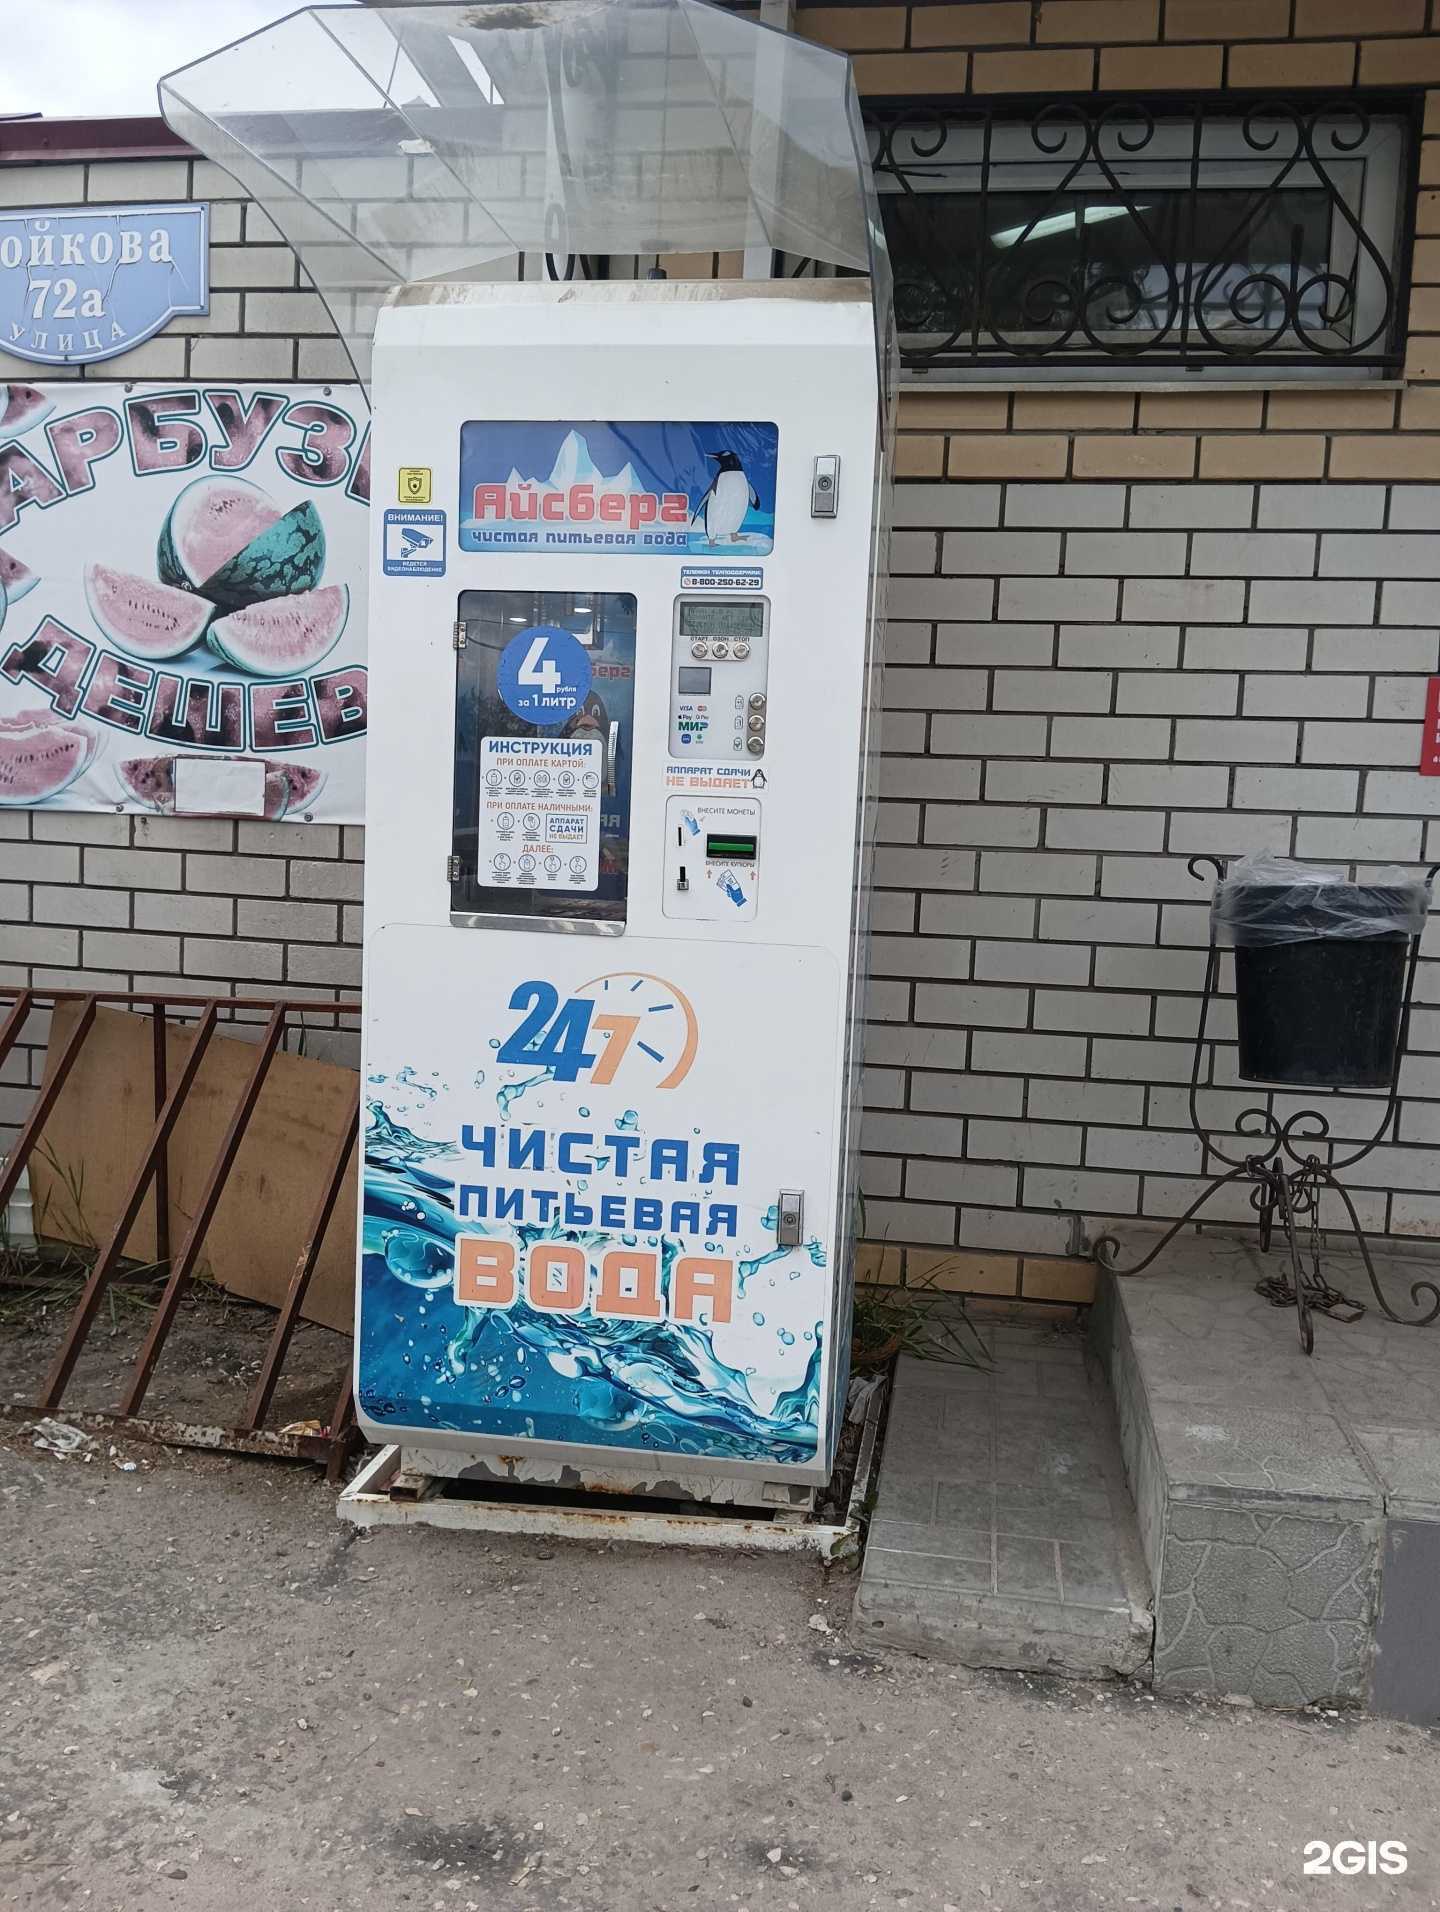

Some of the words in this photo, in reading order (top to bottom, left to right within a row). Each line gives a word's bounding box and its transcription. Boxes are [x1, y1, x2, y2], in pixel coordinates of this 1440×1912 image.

[29, 278, 106, 319] 72а
[9, 320, 127, 351] УЛИЦА
[0, 388, 370, 536] АРБУЗ
[474, 483, 688, 530] Айсберг
[387, 513, 443, 522] ВНИМАНИЕ!
[472, 531, 538, 543] чистая
[545, 532, 636, 545] питьевая
[643, 531, 688, 546] вода
[518, 637, 561, 694] 4
[518, 699, 530, 707] за
[532, 695, 540, 706] 1
[542, 696, 577, 709] литр
[489, 740, 592, 757] ИНСТРУКЦИЯ
[496, 757, 515, 766] ПРИ
[516, 758, 549, 767] ОПЛАТЕ
[666, 766, 713, 775] АППАРАТ
[716, 768, 751, 777] СДАЧИ
[666, 776, 685, 787] НЕ
[689, 777, 751, 789] ВЫДАЕТ
[486, 801, 503, 809] ПРИ
[505, 802, 536, 811] ОПЛАТЕ
[549, 817, 584, 825] АППАРАТ
[549, 825, 584, 833] СДАЧИ
[461, 1124, 740, 1186] ЧИСТАЯ
[458, 1184, 738, 1238] ПИТЬЕВАЯ
[458, 1237, 735, 1324] ВОДА
